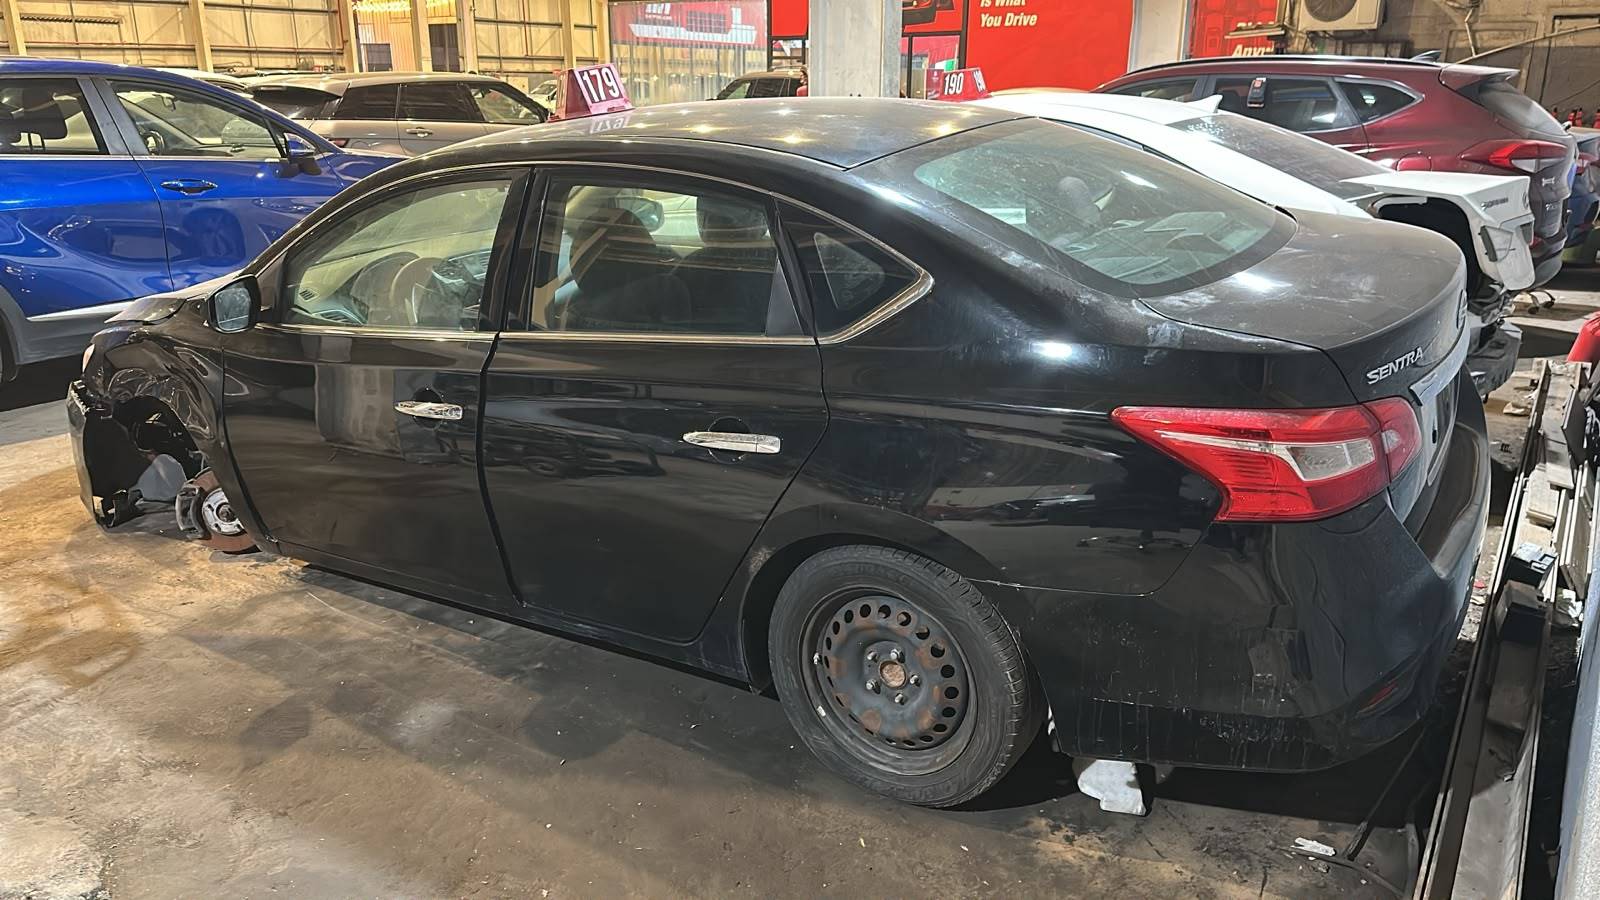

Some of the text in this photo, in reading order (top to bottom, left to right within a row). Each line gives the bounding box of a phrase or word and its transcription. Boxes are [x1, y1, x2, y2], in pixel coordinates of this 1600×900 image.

[981, 12, 1038, 28] You Drive
[583, 67, 620, 102] 179
[944, 72, 964, 95] 190
[1366, 346, 1423, 385] SENTRA
